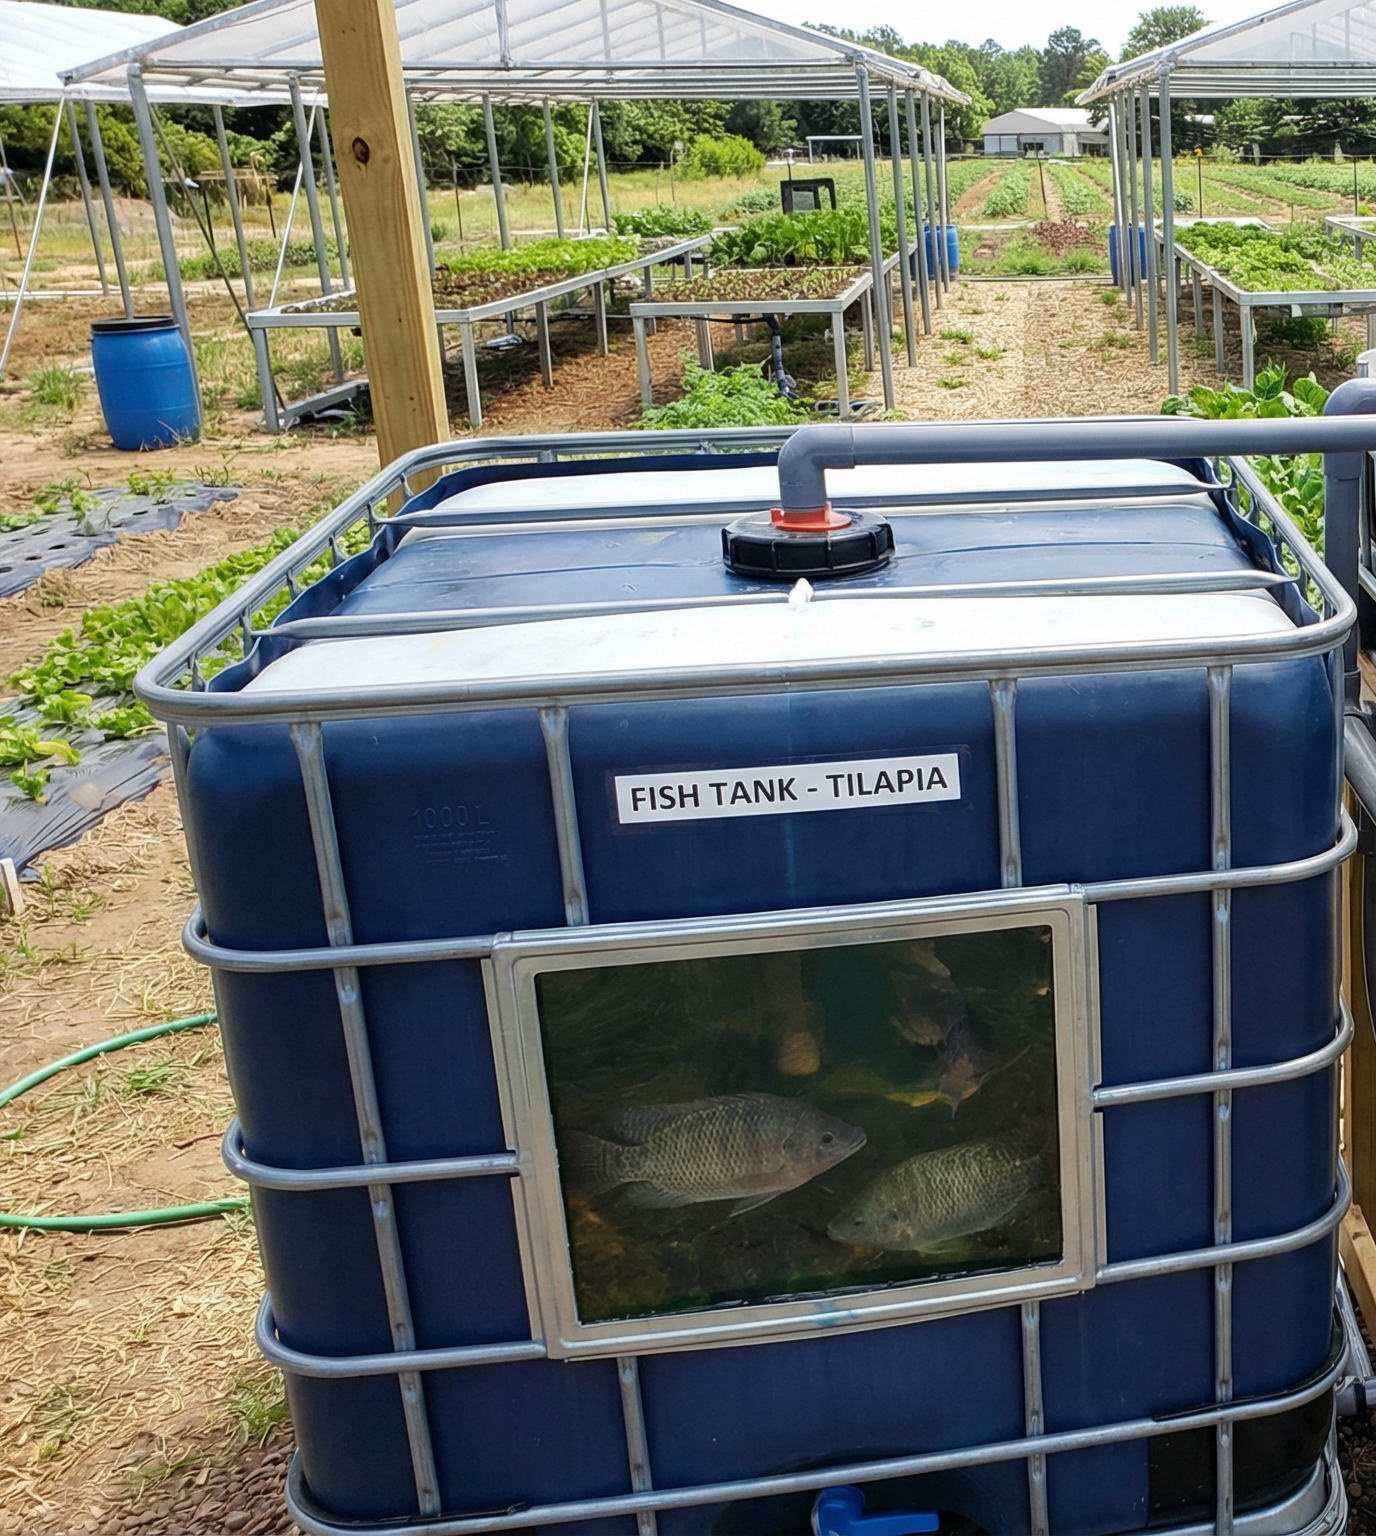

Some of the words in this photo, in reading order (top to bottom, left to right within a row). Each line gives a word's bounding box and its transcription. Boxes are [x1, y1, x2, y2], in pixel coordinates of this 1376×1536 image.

[631, 783, 700, 812] FISH
[709, 777, 798, 807] TANK
[825, 766, 949, 798] TILAPIA
[412, 805, 468, 828] 1000
